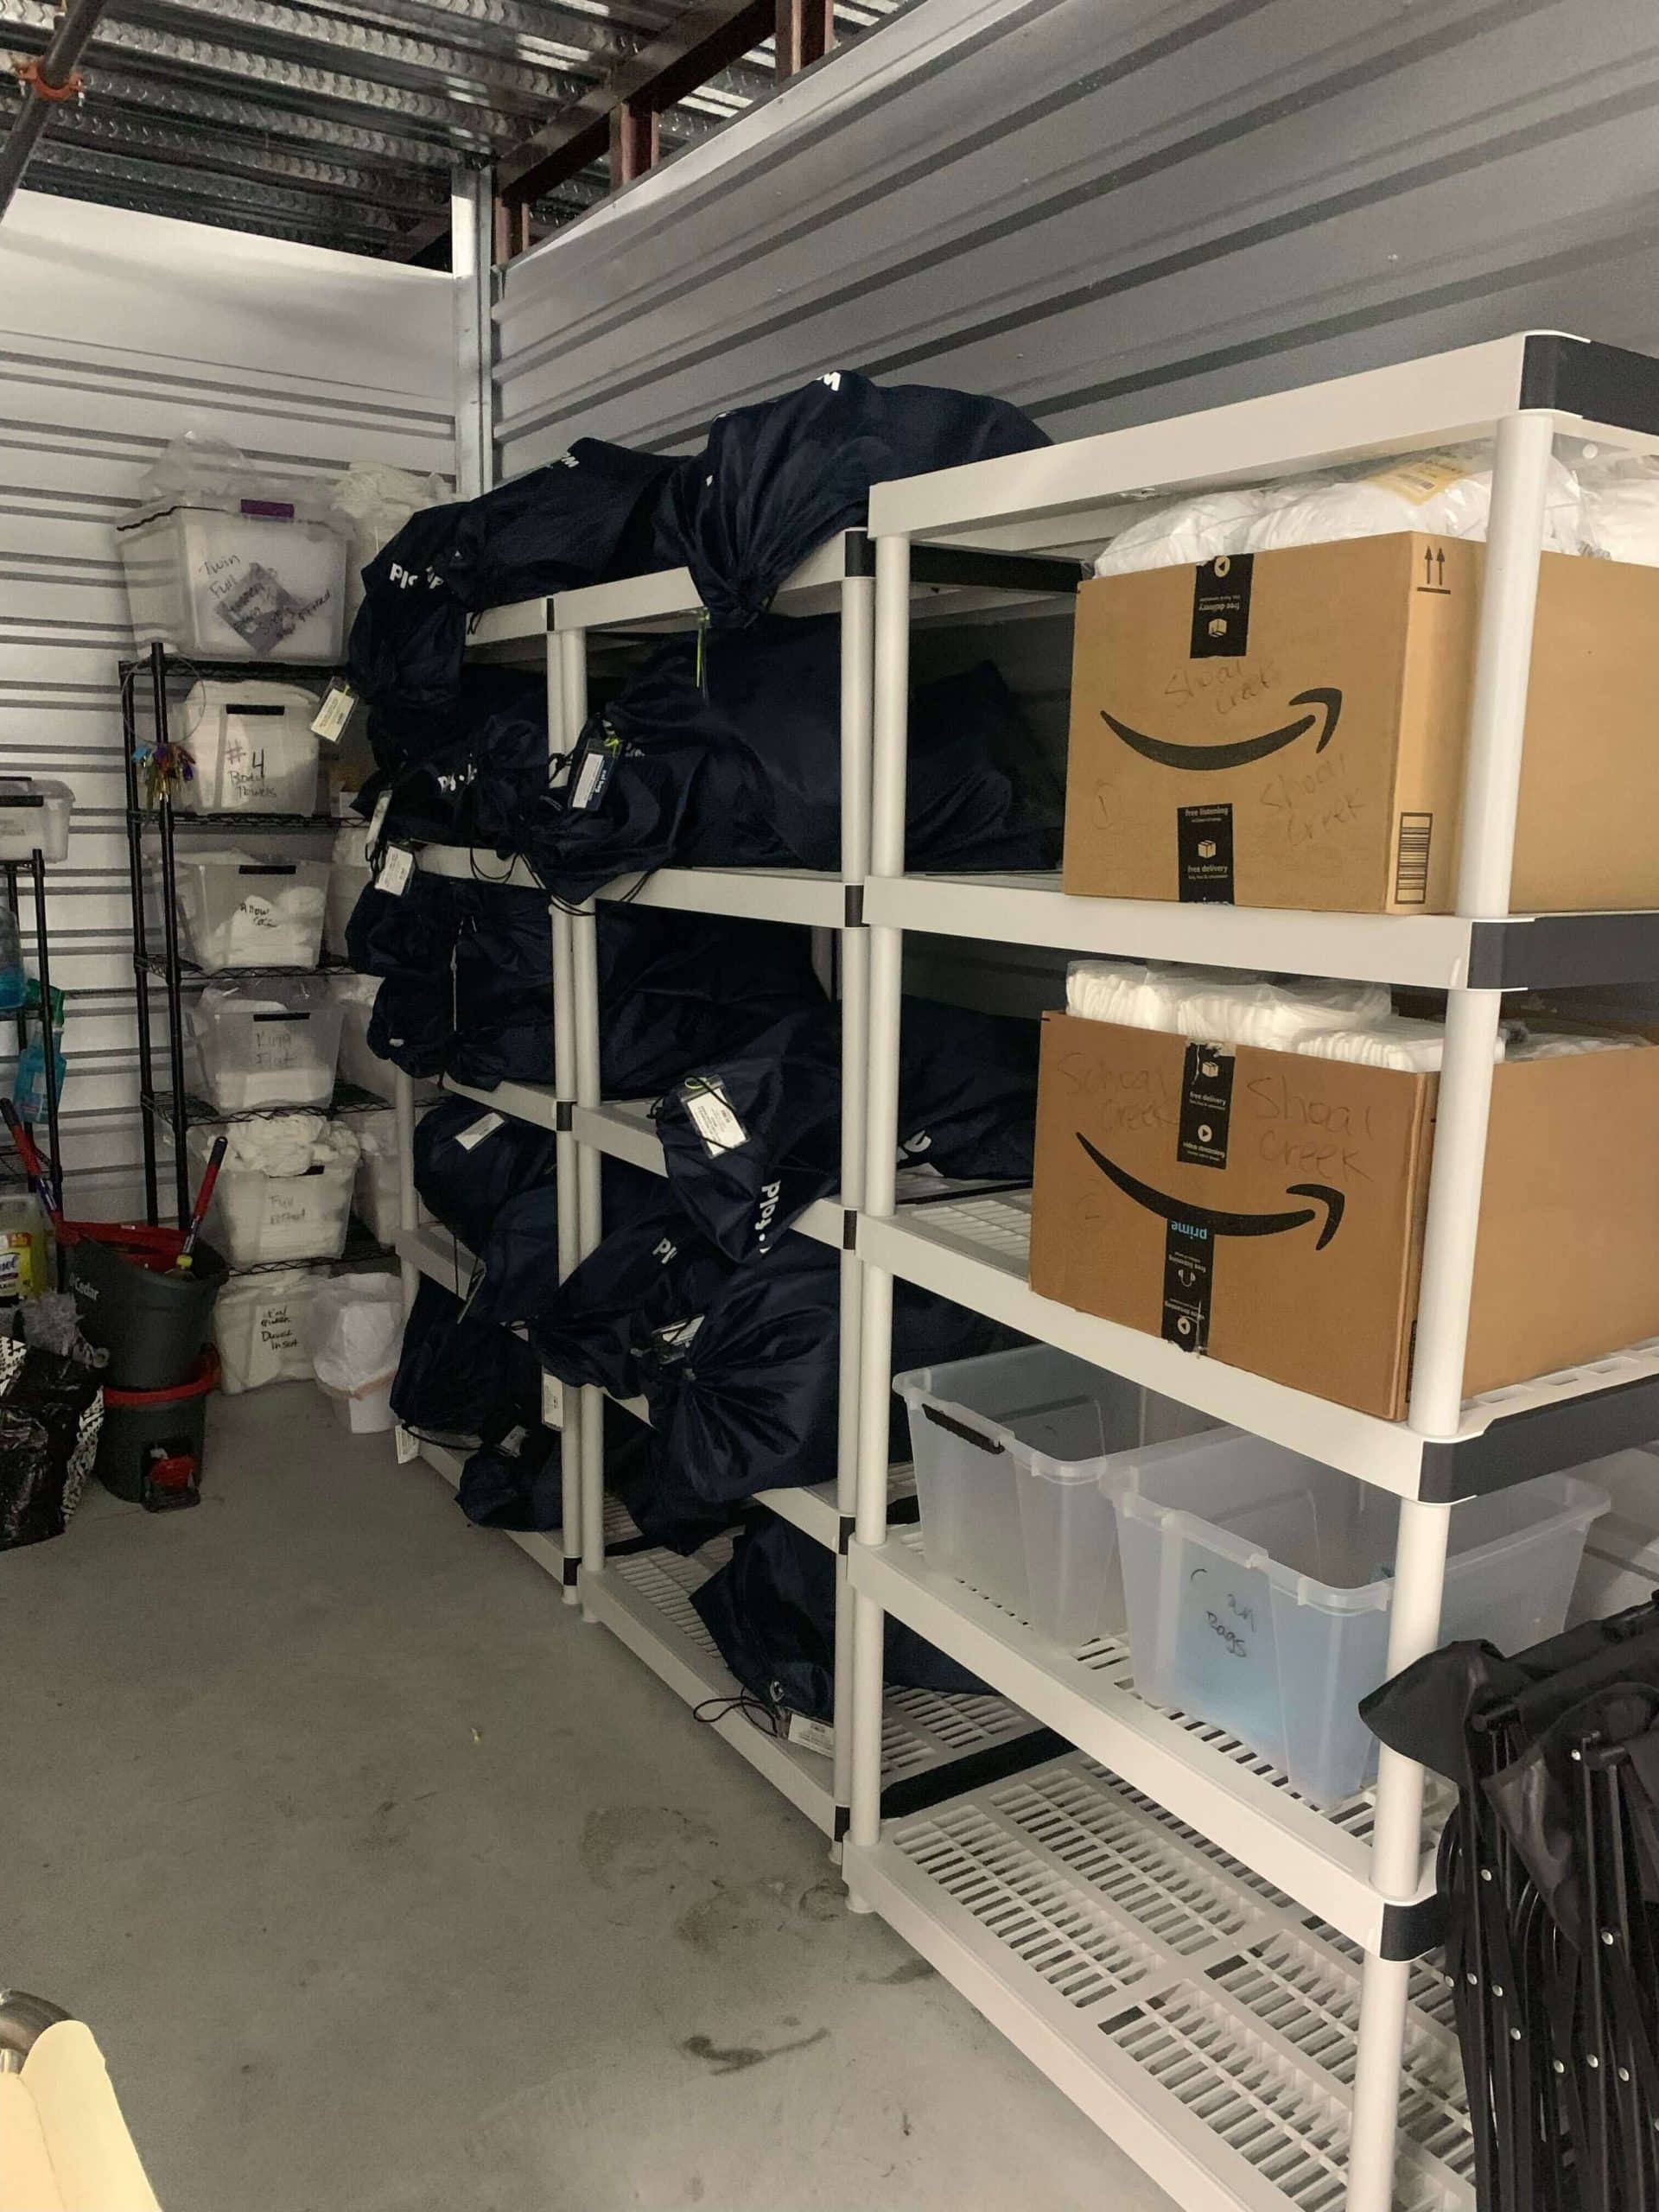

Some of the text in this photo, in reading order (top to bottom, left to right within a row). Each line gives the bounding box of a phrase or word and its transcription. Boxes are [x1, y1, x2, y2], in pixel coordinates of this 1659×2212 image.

[1247, 1075, 1374, 1141] Shoal
[1260, 1129, 1375, 1183] Creek
[1171, 1220, 1208, 1241] prime
